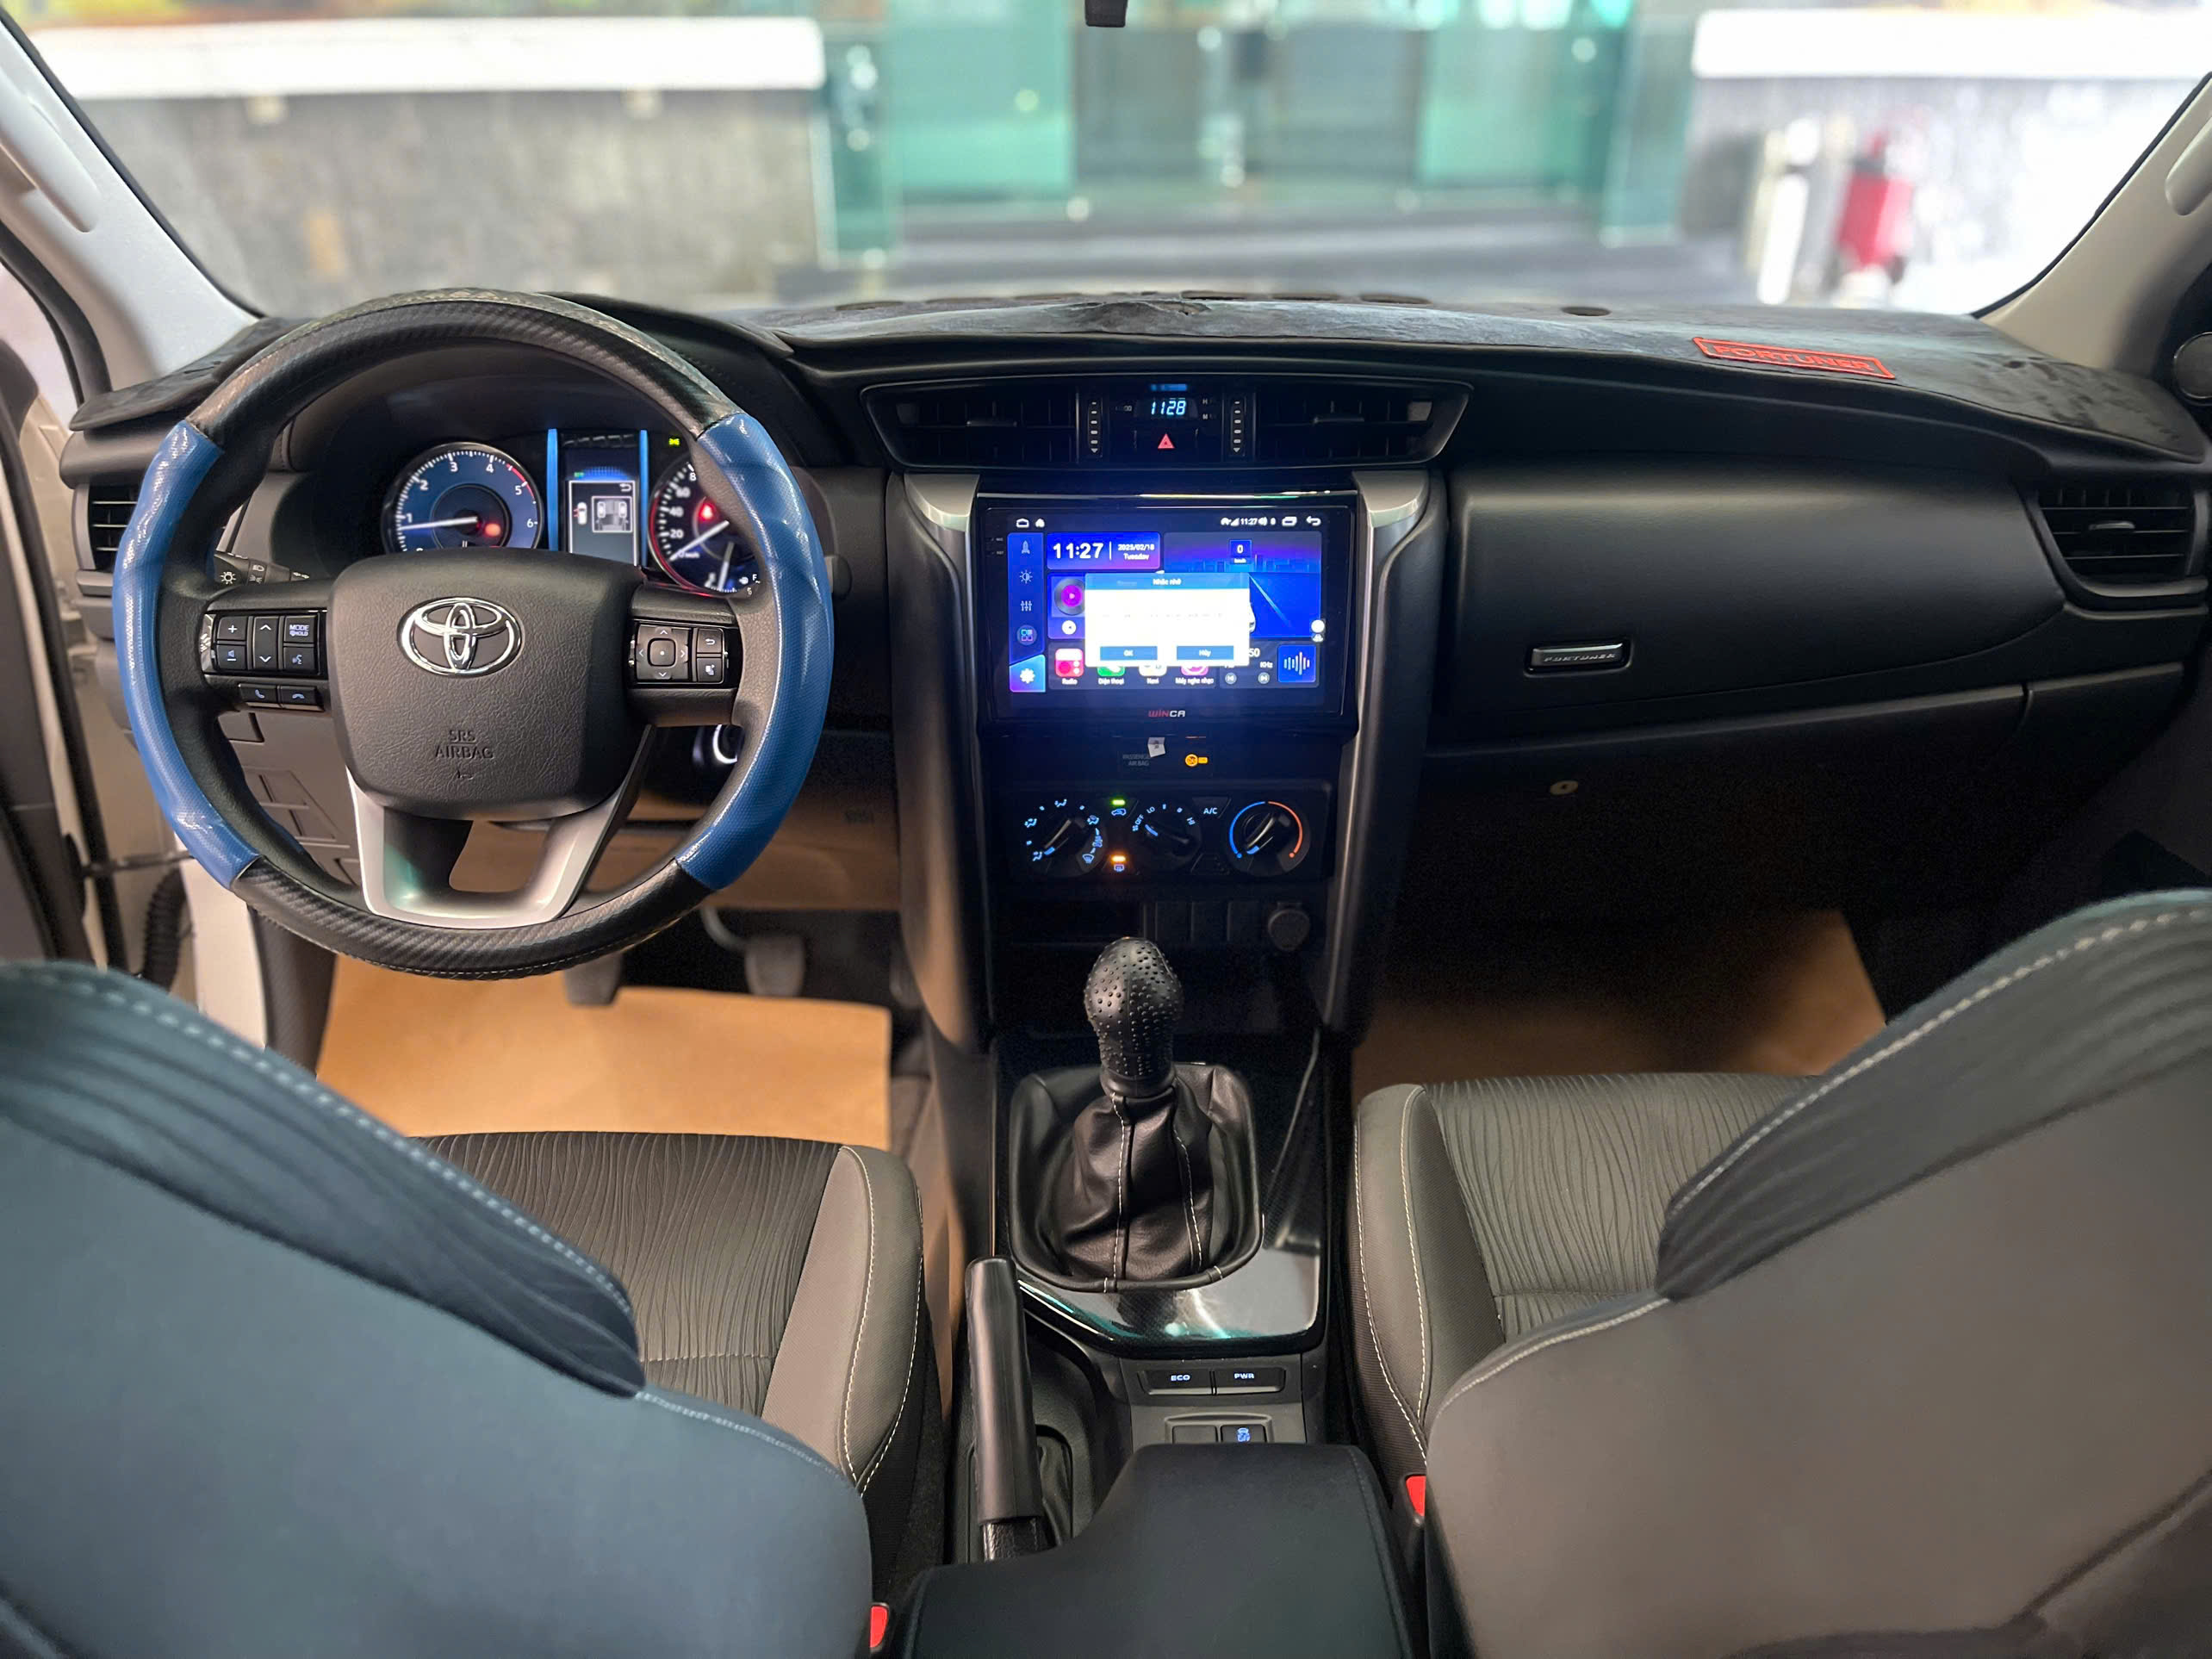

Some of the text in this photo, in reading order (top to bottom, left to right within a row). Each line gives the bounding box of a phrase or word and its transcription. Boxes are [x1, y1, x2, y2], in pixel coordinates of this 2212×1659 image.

[1713, 345, 1874, 371] FORTUNER
[450, 462, 458, 472] 3
[486, 462, 494, 473] 4
[419, 480, 428, 491] 2
[515, 485, 522, 495] 5
[675, 488, 691, 498] 60
[669, 506, 684, 517] 40
[406, 513, 413, 523] 1
[670, 529, 684, 539] 20
[1053, 543, 1103, 559] 11:27
[1237, 544, 1244, 553] 0
[1544, 653, 1616, 662] FORTUNER
[449, 730, 476, 742] SRS
[435, 745, 494, 759] AIRBAG
[1134, 814, 1144, 825] OFF
[1186, 817, 1196, 826] HI
